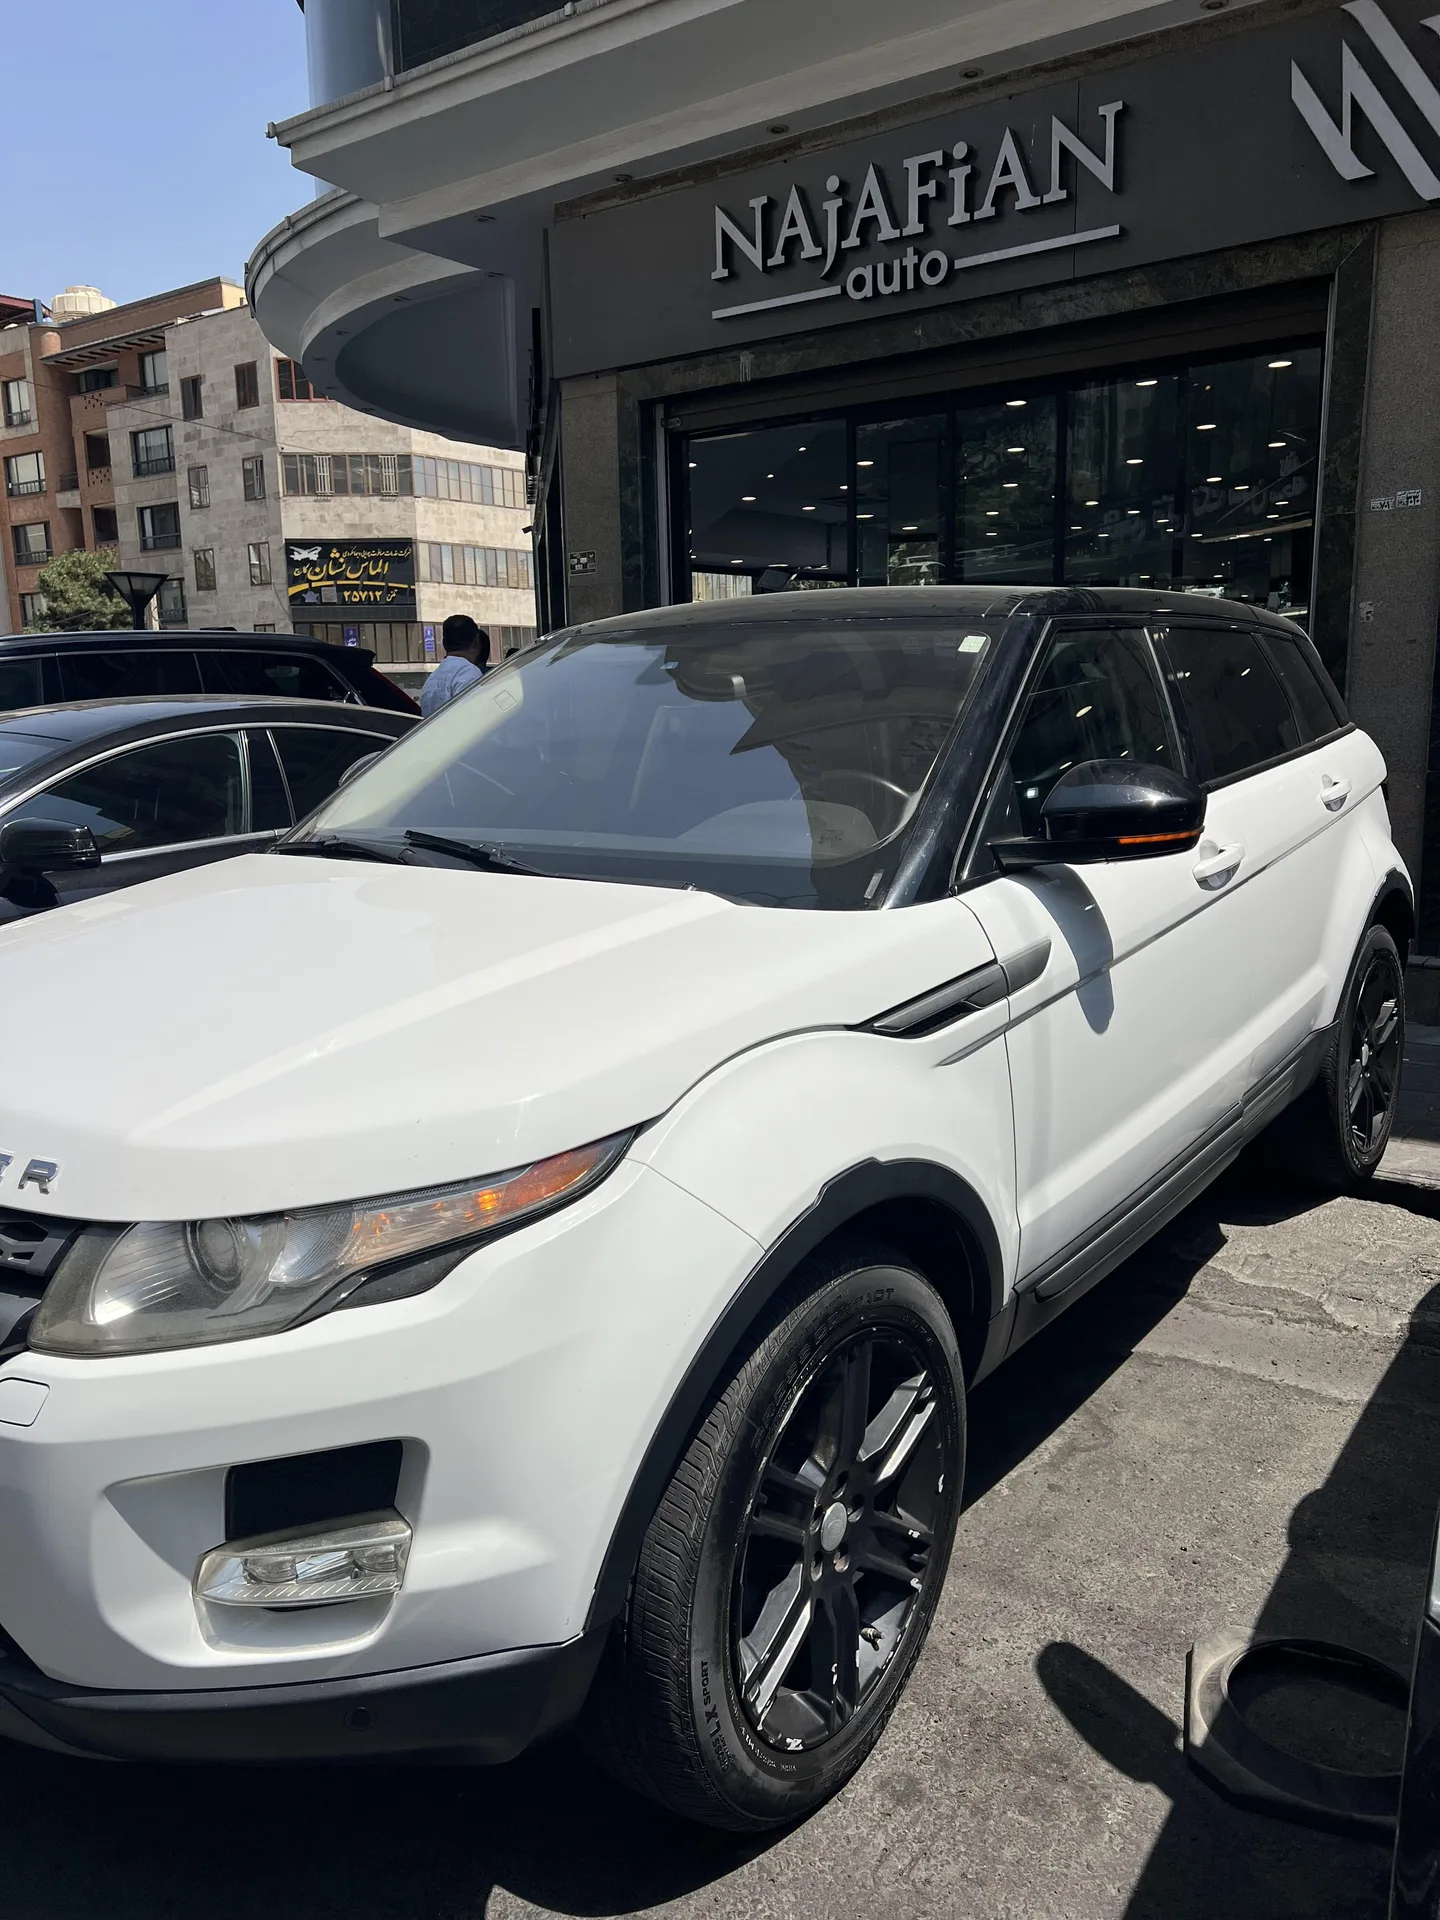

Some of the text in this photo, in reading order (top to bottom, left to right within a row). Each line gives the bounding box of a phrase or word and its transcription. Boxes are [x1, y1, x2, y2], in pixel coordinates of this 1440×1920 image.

[846, 246, 948, 300] auto
[307, 548, 347, 581] نشان
[346, 558, 389, 579] الماس
[343, 590, 383, 602] ۲۵۷۱۲
[701, 1660, 711, 1706] SPORT
[705, 1703, 721, 1739] LX
